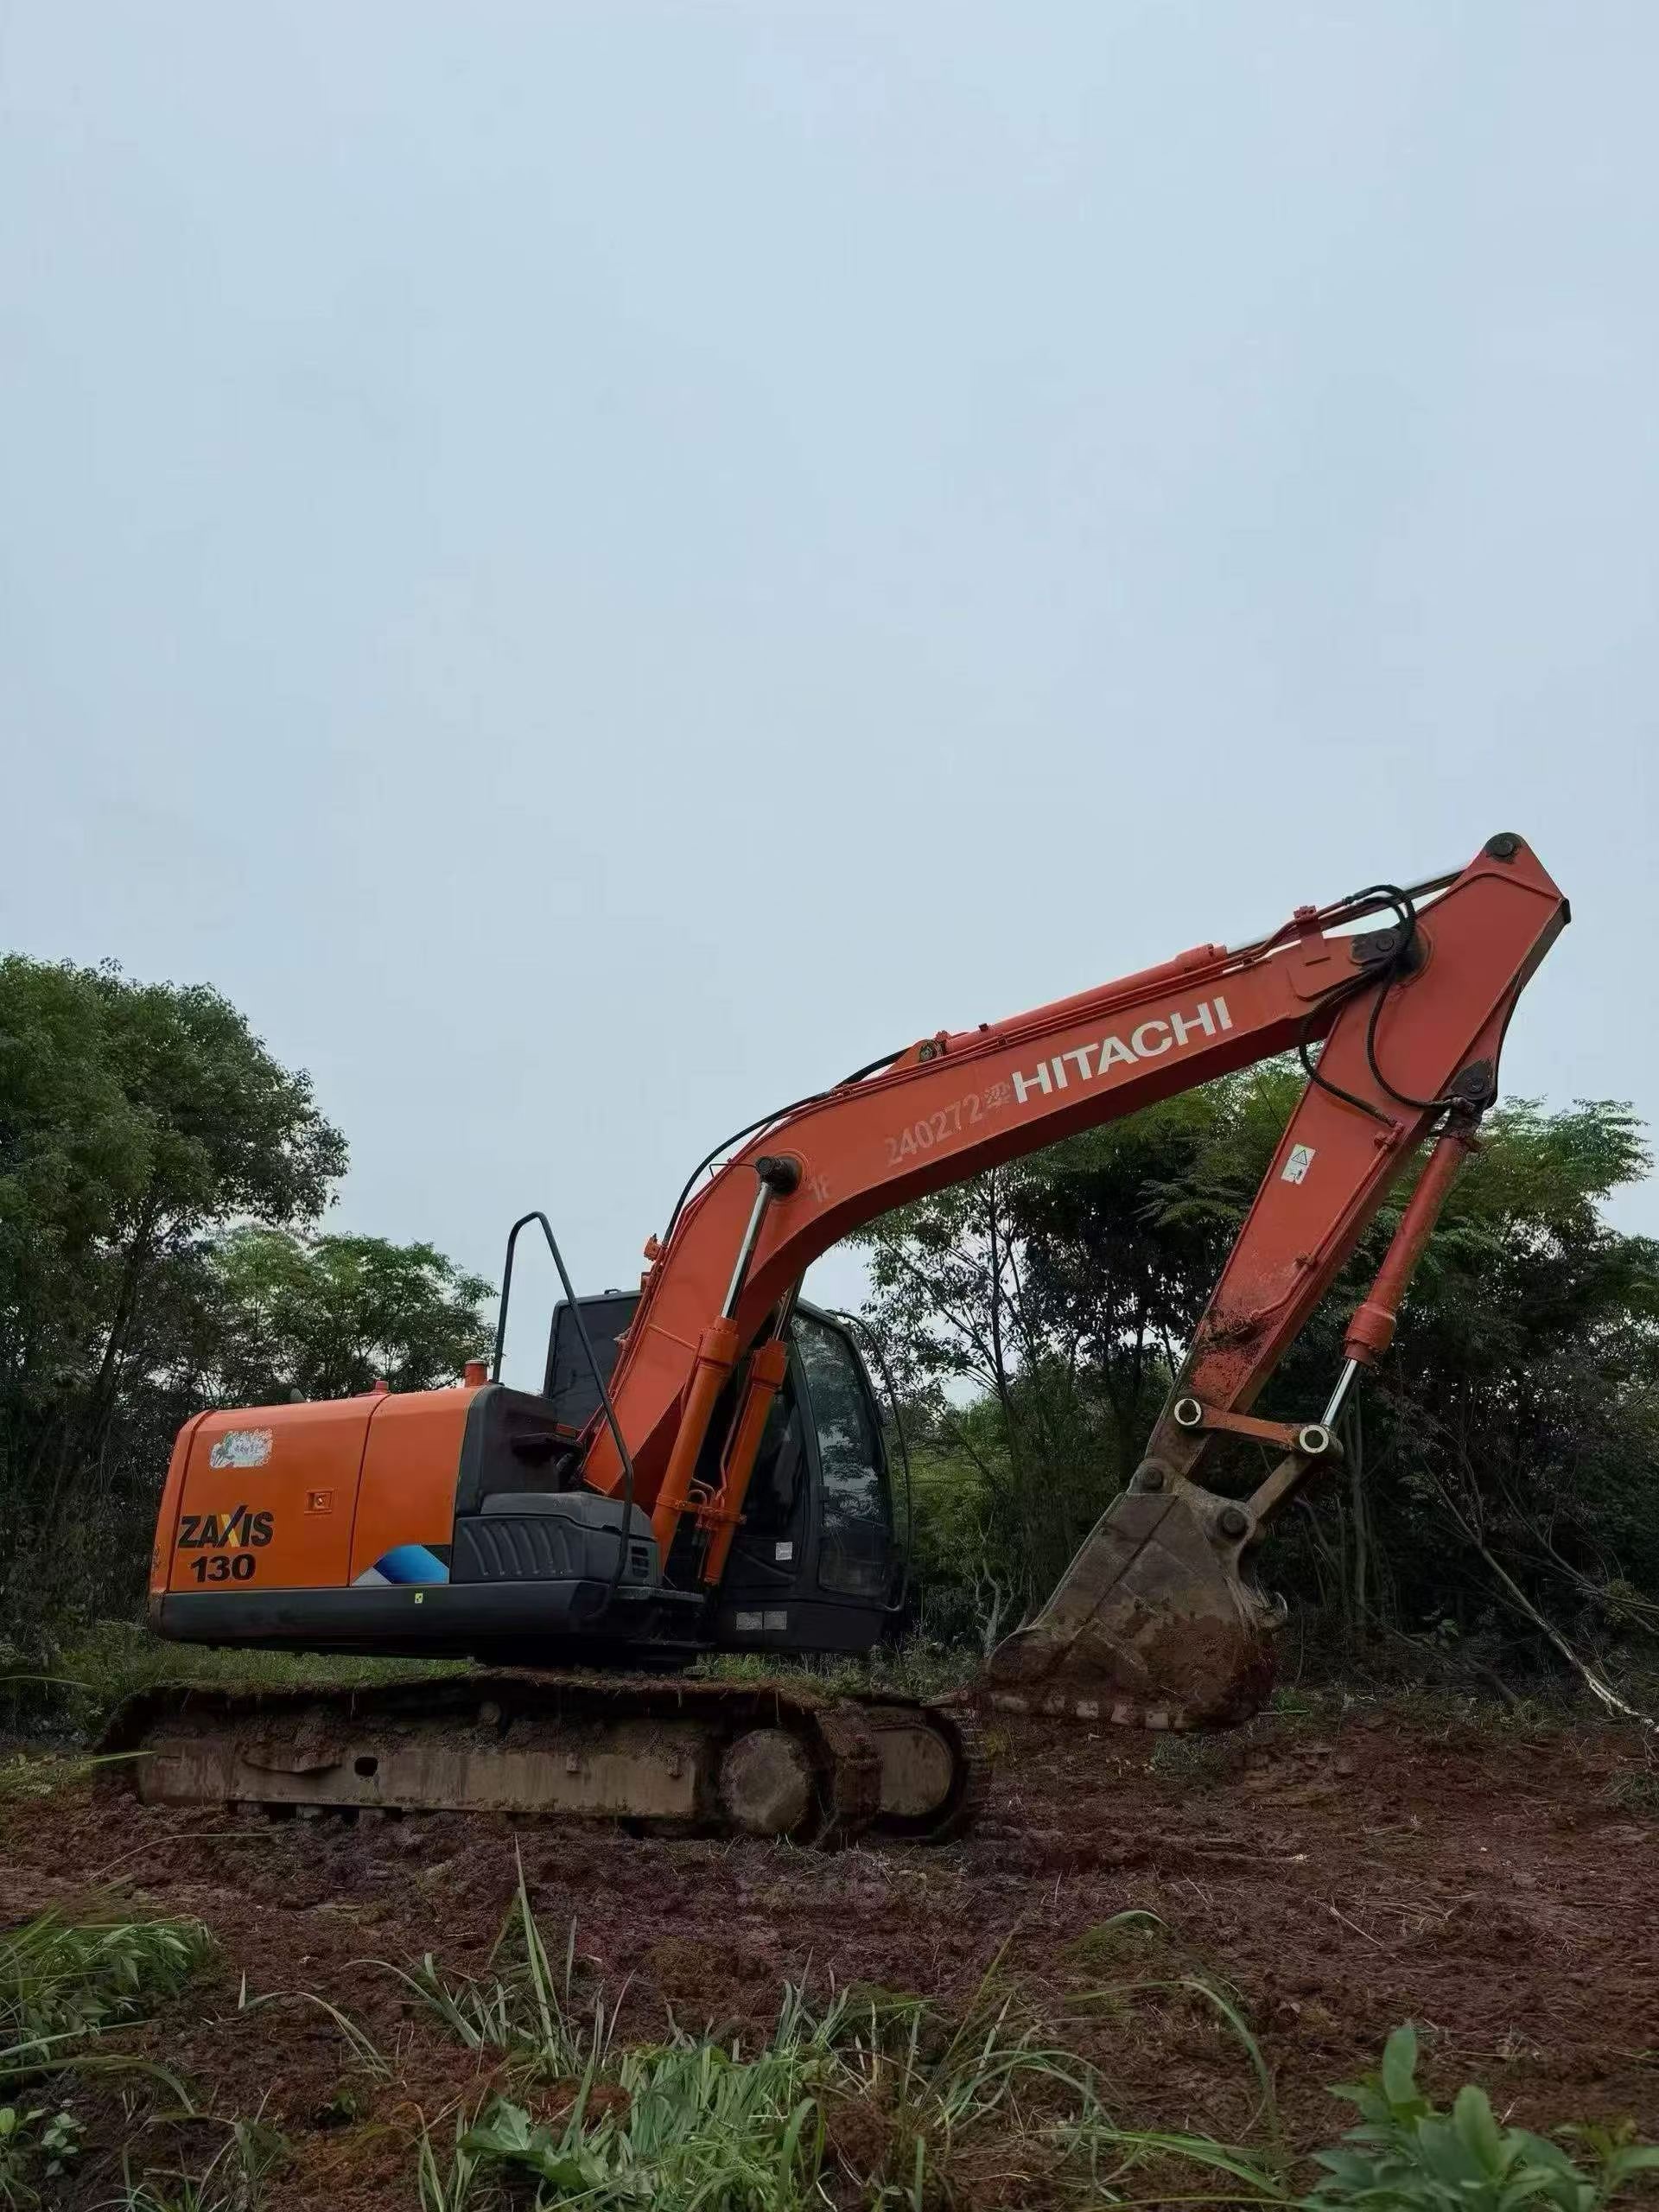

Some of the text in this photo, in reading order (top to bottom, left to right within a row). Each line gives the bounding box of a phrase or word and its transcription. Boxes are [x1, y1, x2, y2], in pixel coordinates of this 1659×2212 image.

[1011, 995, 1233, 1104] HITACHI
[177, 1504, 275, 1549] ZAXIS
[190, 1554, 257, 1583] 130
